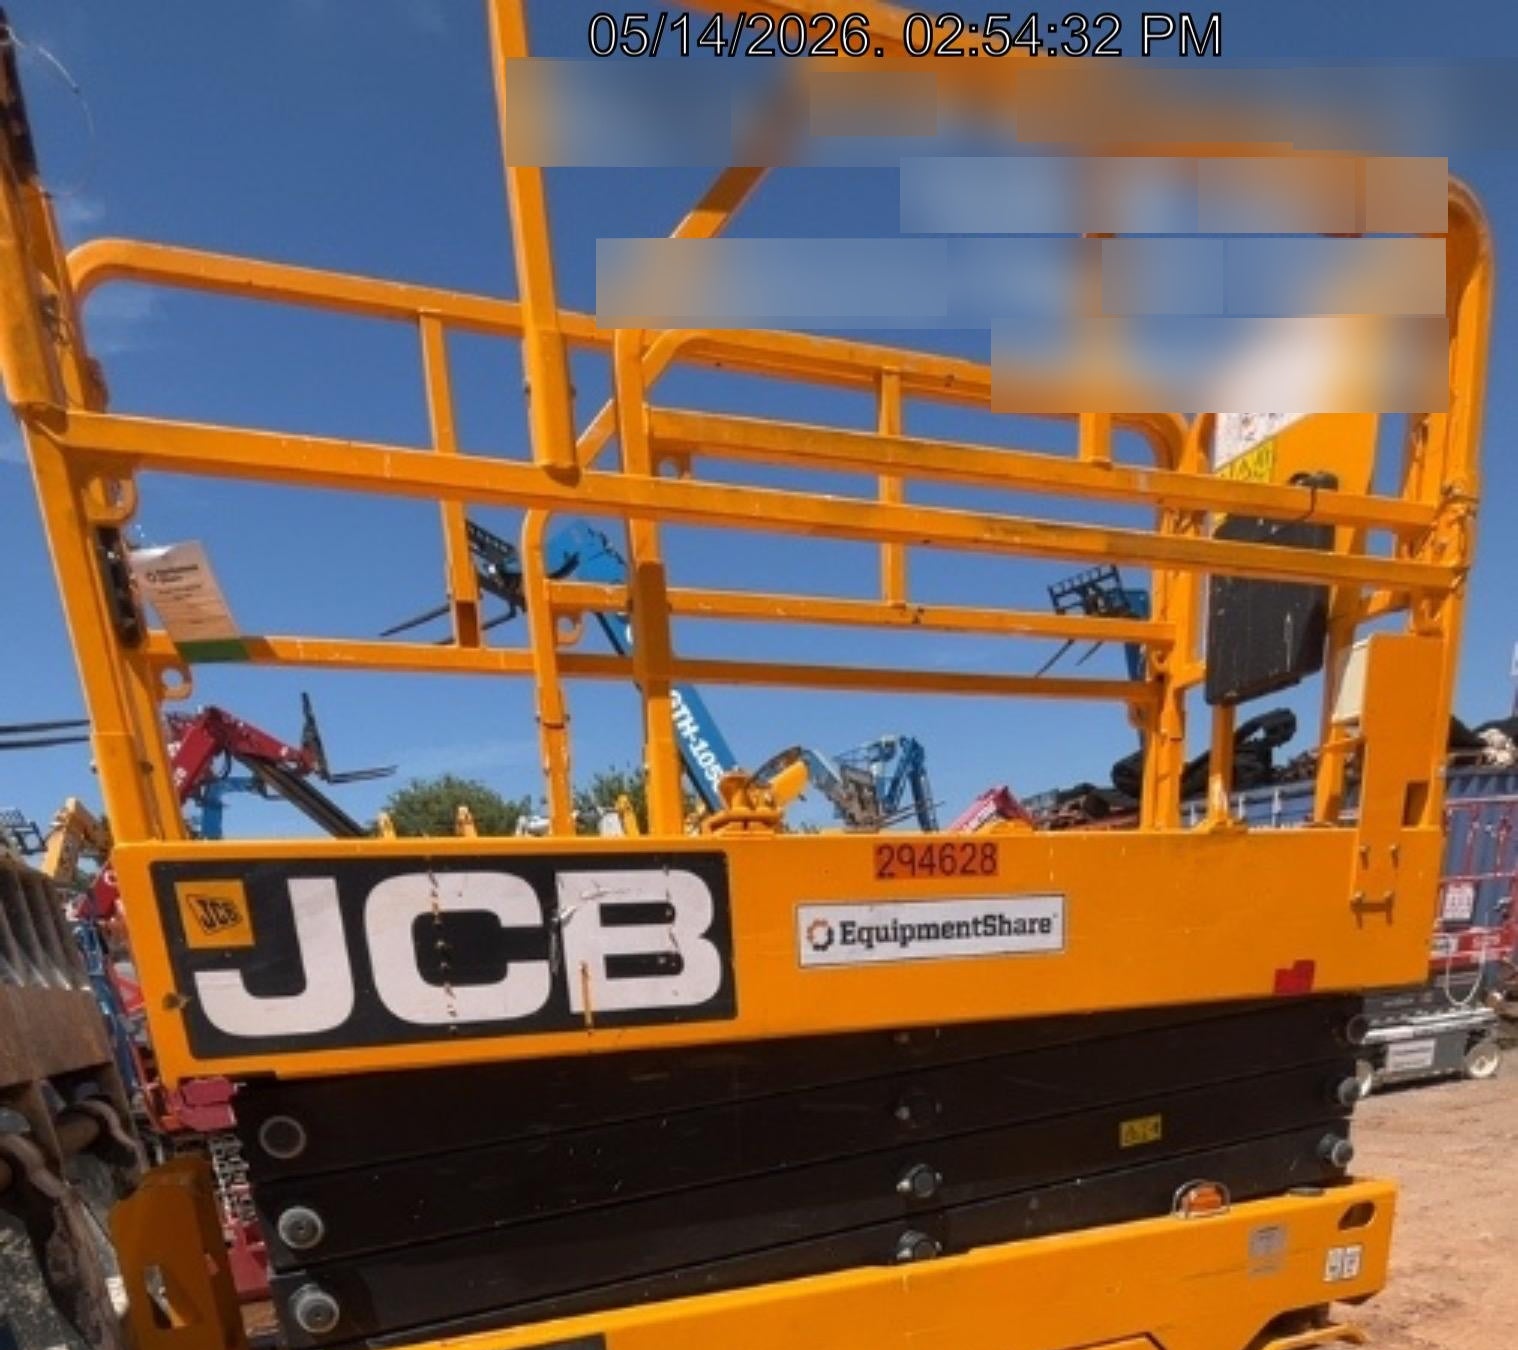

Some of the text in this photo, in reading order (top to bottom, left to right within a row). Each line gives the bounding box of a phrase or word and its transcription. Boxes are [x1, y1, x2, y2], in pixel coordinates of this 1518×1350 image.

[670, 688, 723, 793] GTH-105
[876, 843, 997, 879] 294628
[196, 898, 239, 929] JCB
[839, 913, 1051, 948] EquipmentShare
[194, 869, 722, 1037] JCB
